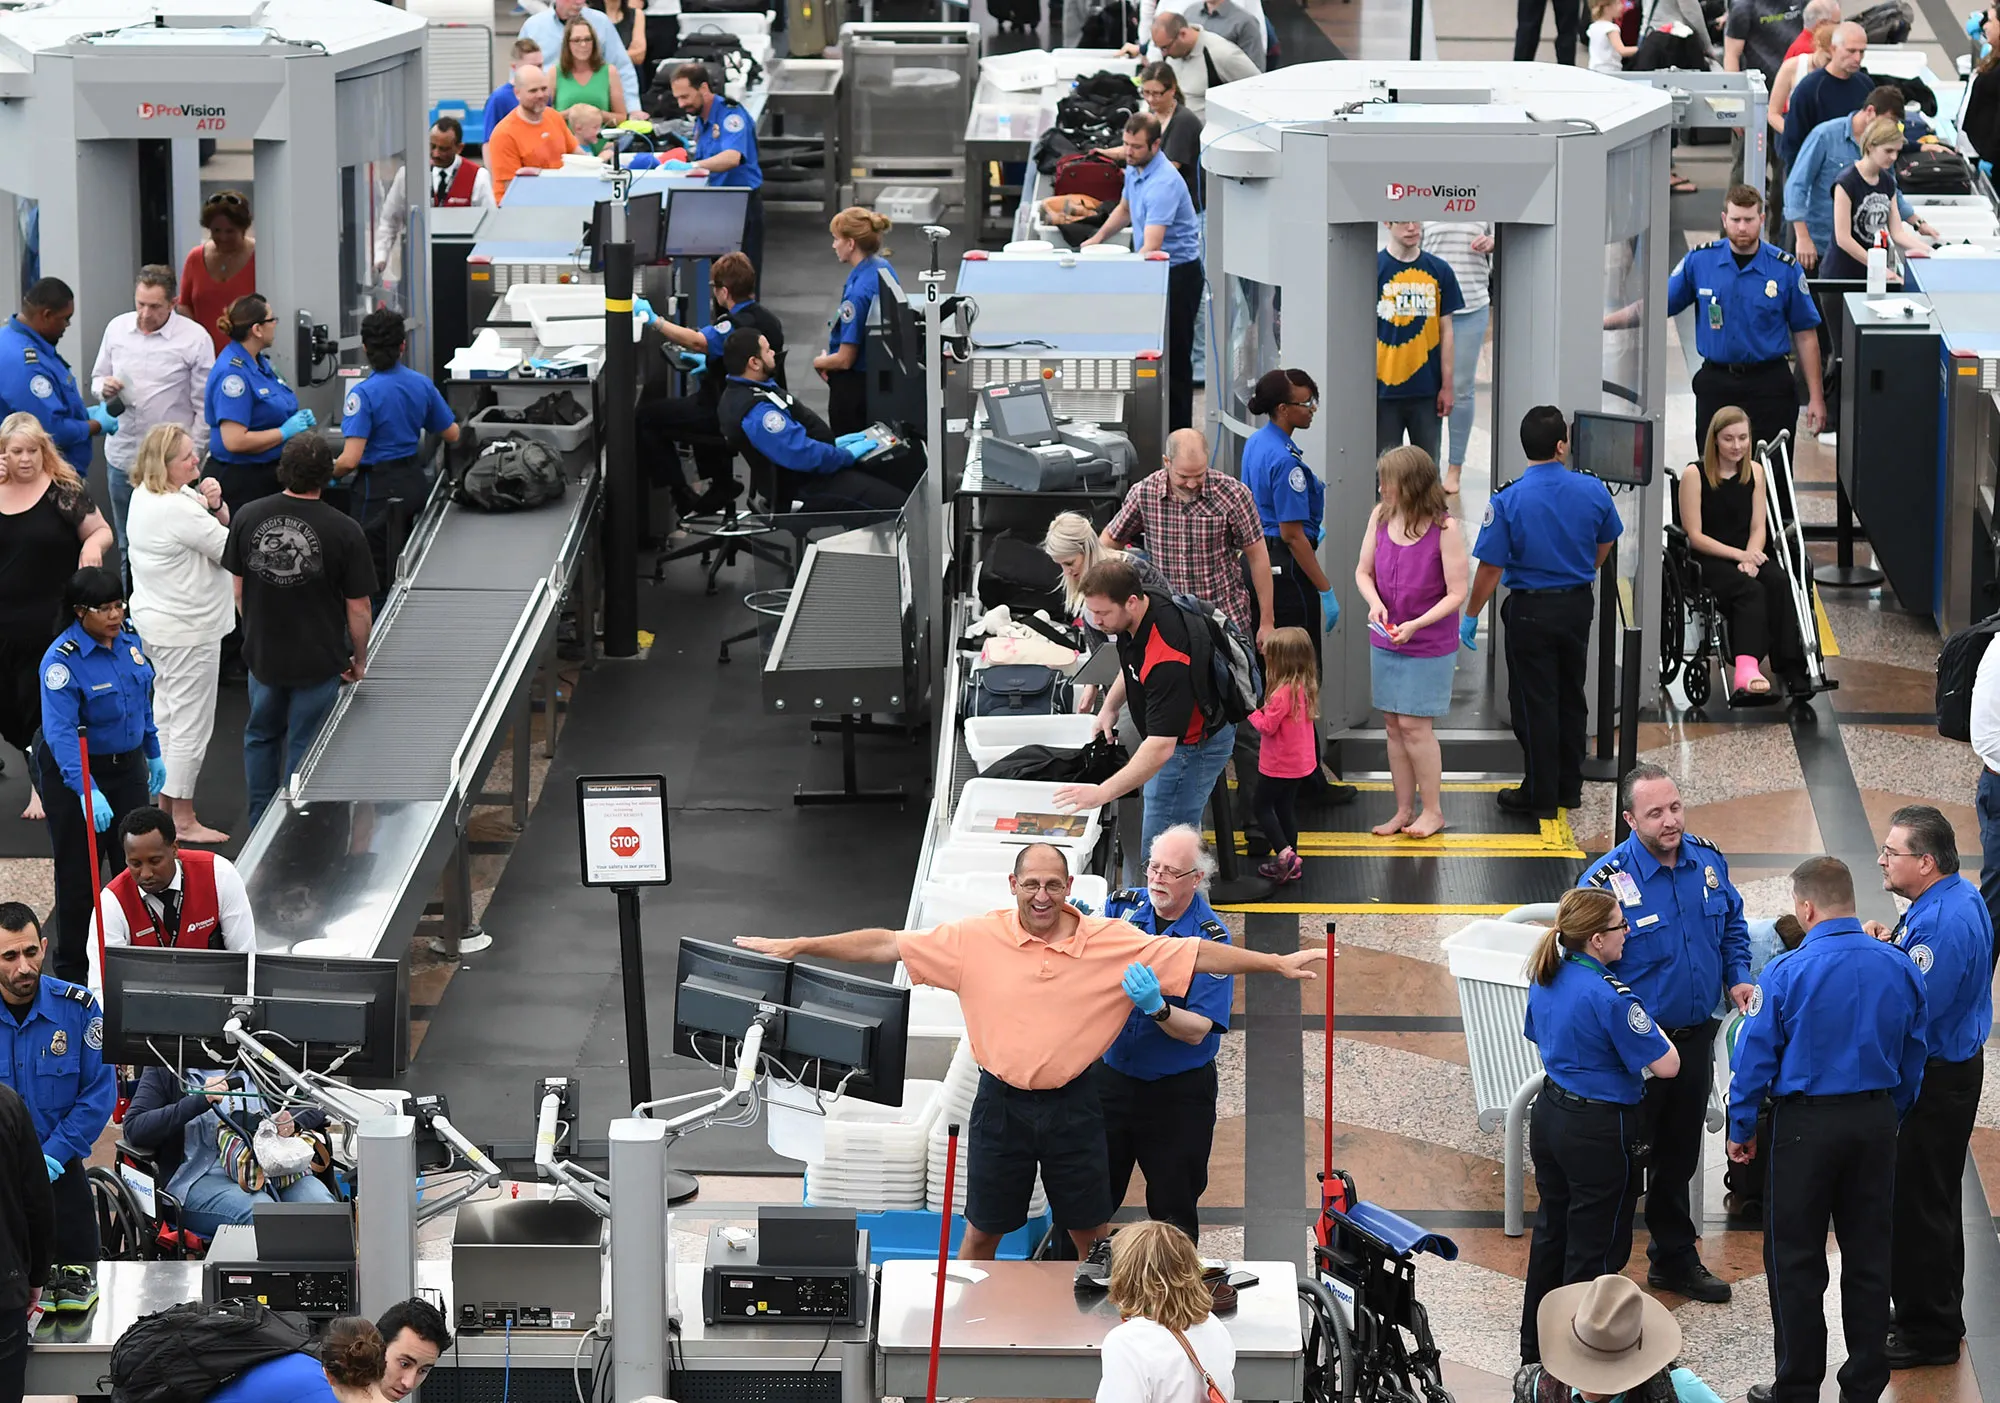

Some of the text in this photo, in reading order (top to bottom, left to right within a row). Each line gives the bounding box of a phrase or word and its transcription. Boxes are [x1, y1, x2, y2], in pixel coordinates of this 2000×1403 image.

[156, 104, 226, 117] ProVision
[196, 118, 226, 130] ATD
[614, 181, 621, 199] 5
[1407, 185, 1476, 197] ProVision
[1444, 199, 1476, 212] ATD
[928, 283, 936, 302] 6
[1383, 282, 1436, 297] SPRING
[1396, 295, 1436, 309] FLING
[252, 518, 320, 553] STURGIS BIKE WEEK
[611, 836, 639, 848] STOP
[122, 1174, 153, 1198] Southwest
